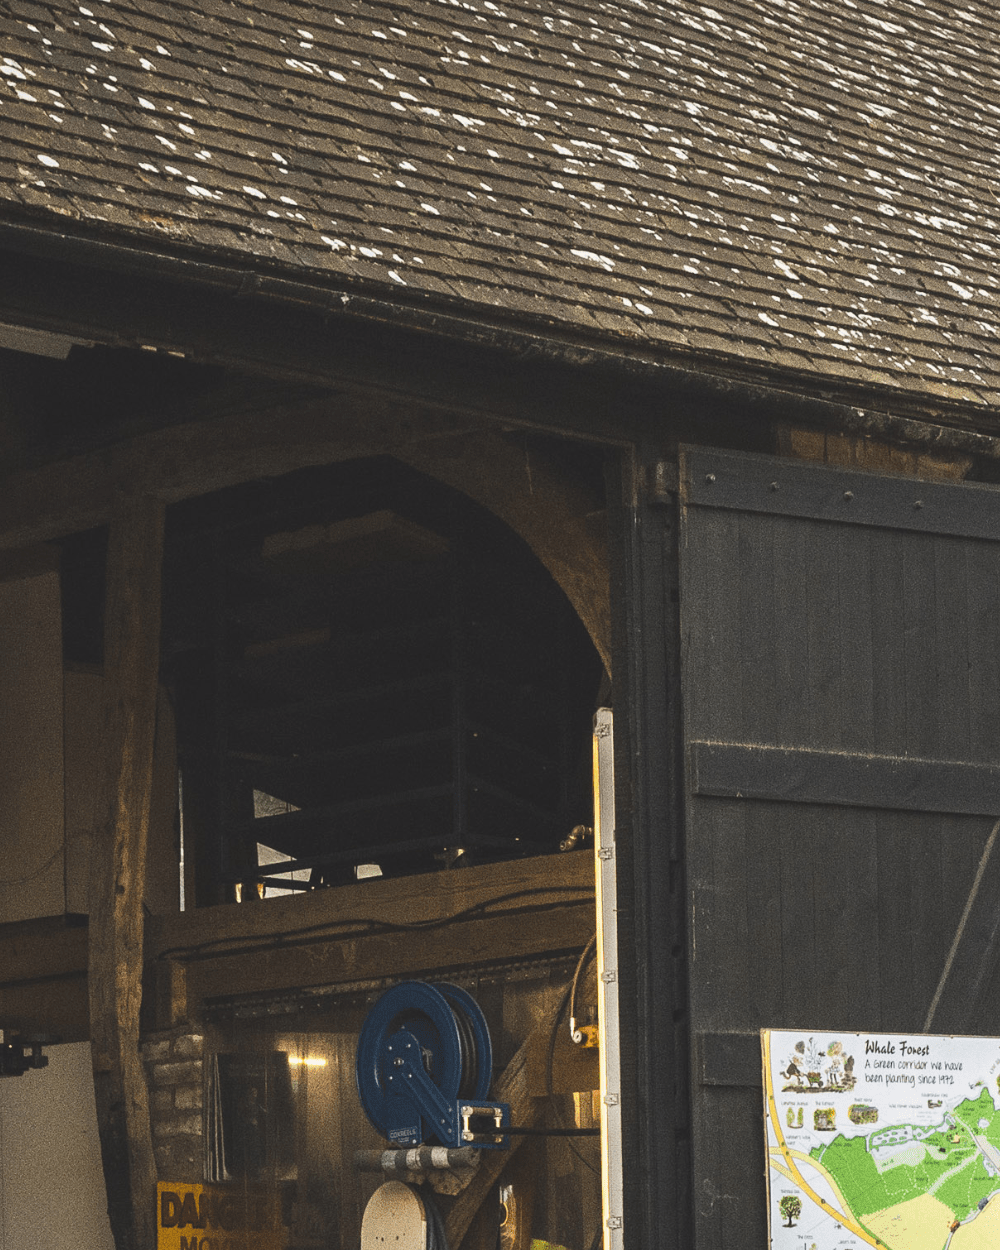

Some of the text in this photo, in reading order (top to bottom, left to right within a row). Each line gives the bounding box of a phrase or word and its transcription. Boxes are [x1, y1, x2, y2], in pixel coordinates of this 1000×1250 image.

[865, 1039, 930, 1057] Whale Forest
[864, 1059, 871, 1069] A
[873, 1059, 896, 1069] Green
[897, 1060, 928, 1070] corridor
[944, 1061, 963, 1071] have
[864, 1073, 955, 1088] been planting since 1972
